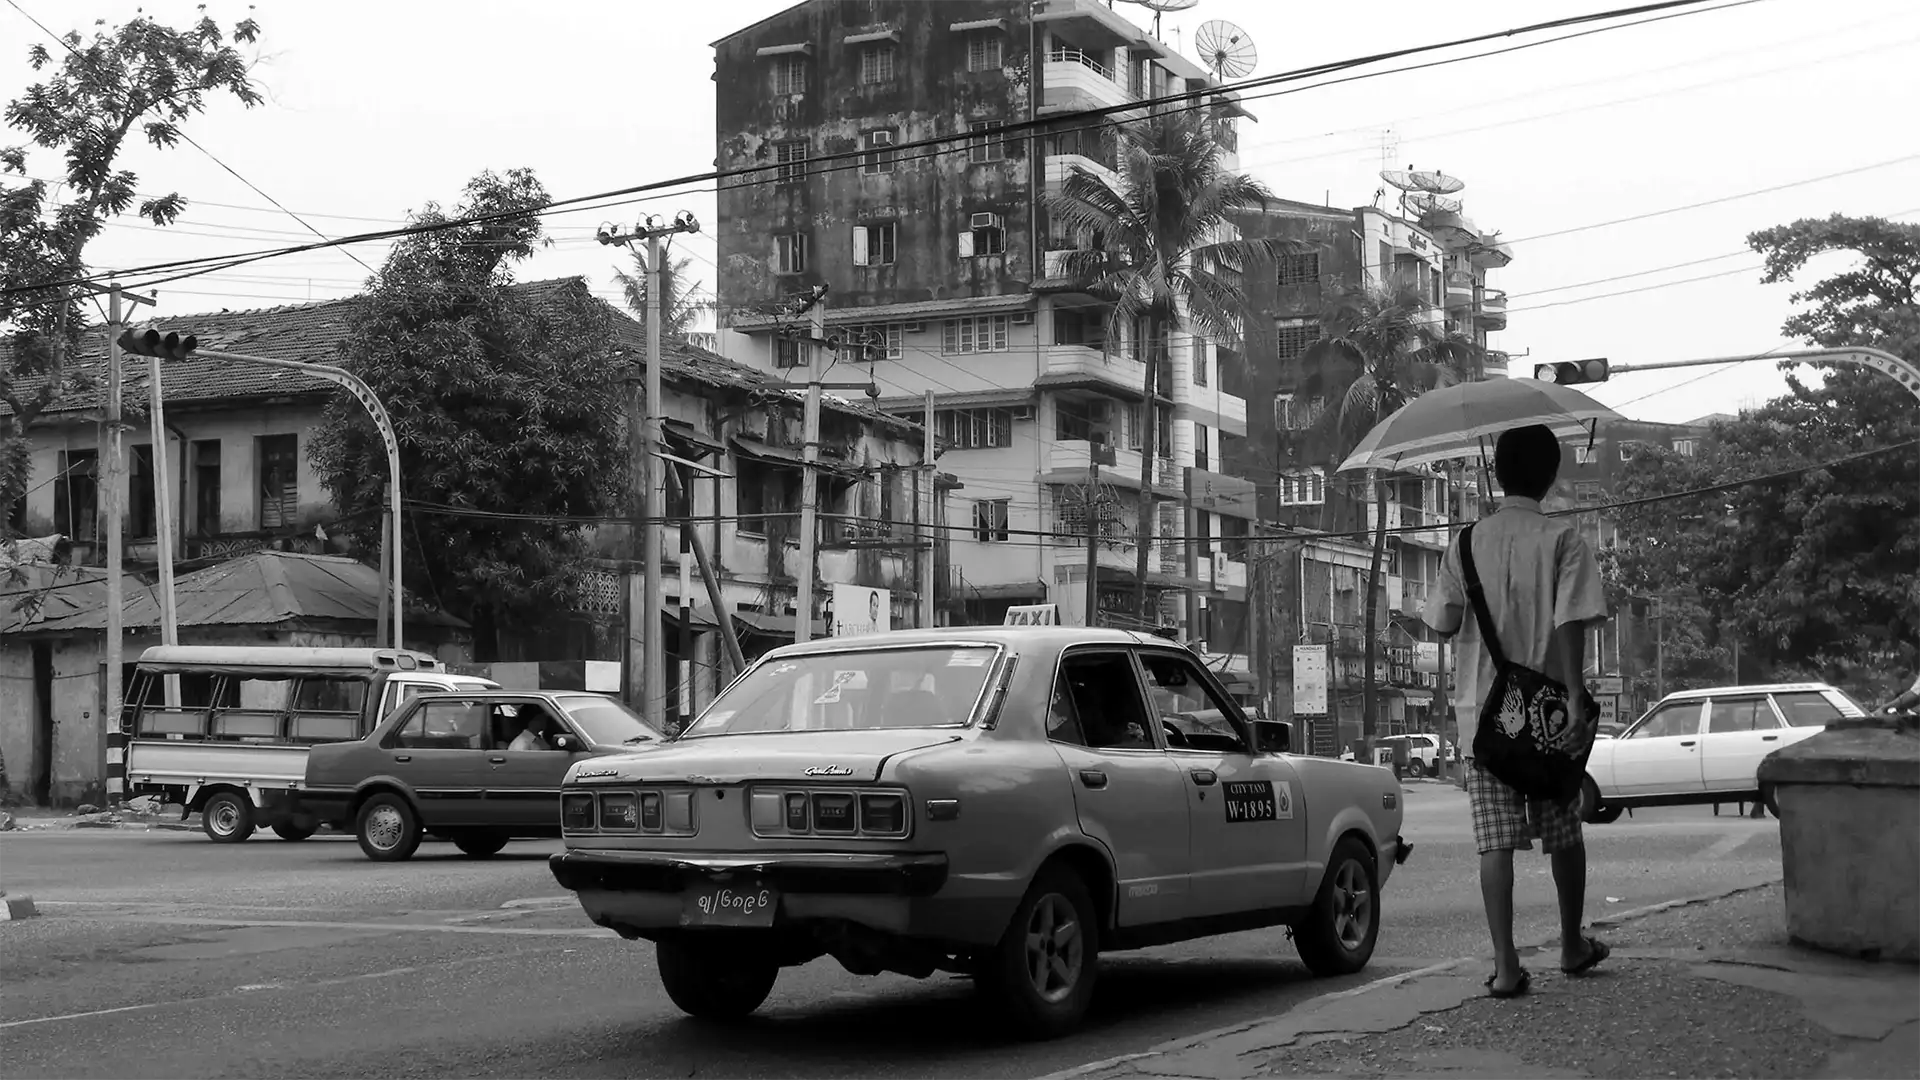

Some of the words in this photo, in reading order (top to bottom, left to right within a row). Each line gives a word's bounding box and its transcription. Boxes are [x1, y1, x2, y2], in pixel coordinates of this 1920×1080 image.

[1008, 609, 1051, 626] TAXI
[1230, 783, 1247, 794] CITY
[1249, 783, 1266, 794] TAXI
